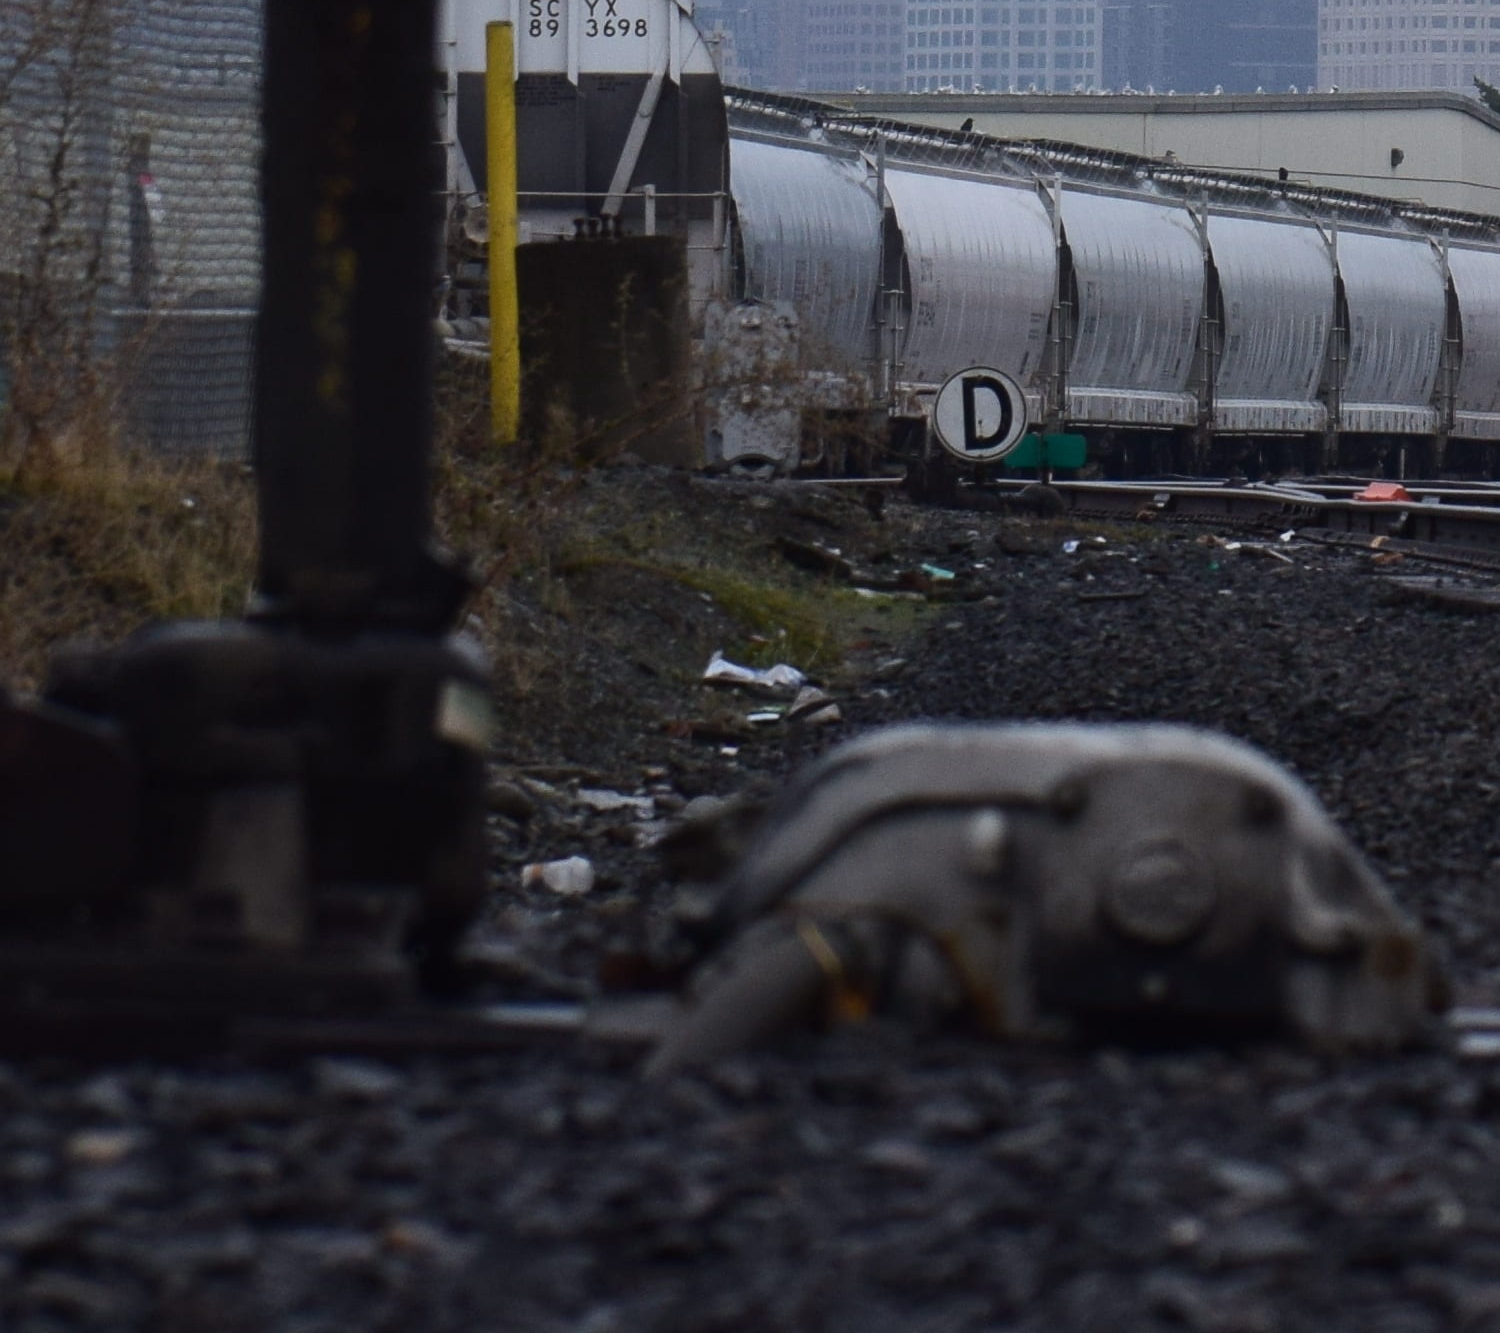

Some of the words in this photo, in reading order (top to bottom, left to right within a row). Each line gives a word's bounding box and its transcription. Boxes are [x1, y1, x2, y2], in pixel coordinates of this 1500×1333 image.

[529, 19, 559, 37] 89
[585, 19, 647, 37] 3698
[962, 375, 1012, 450] D
